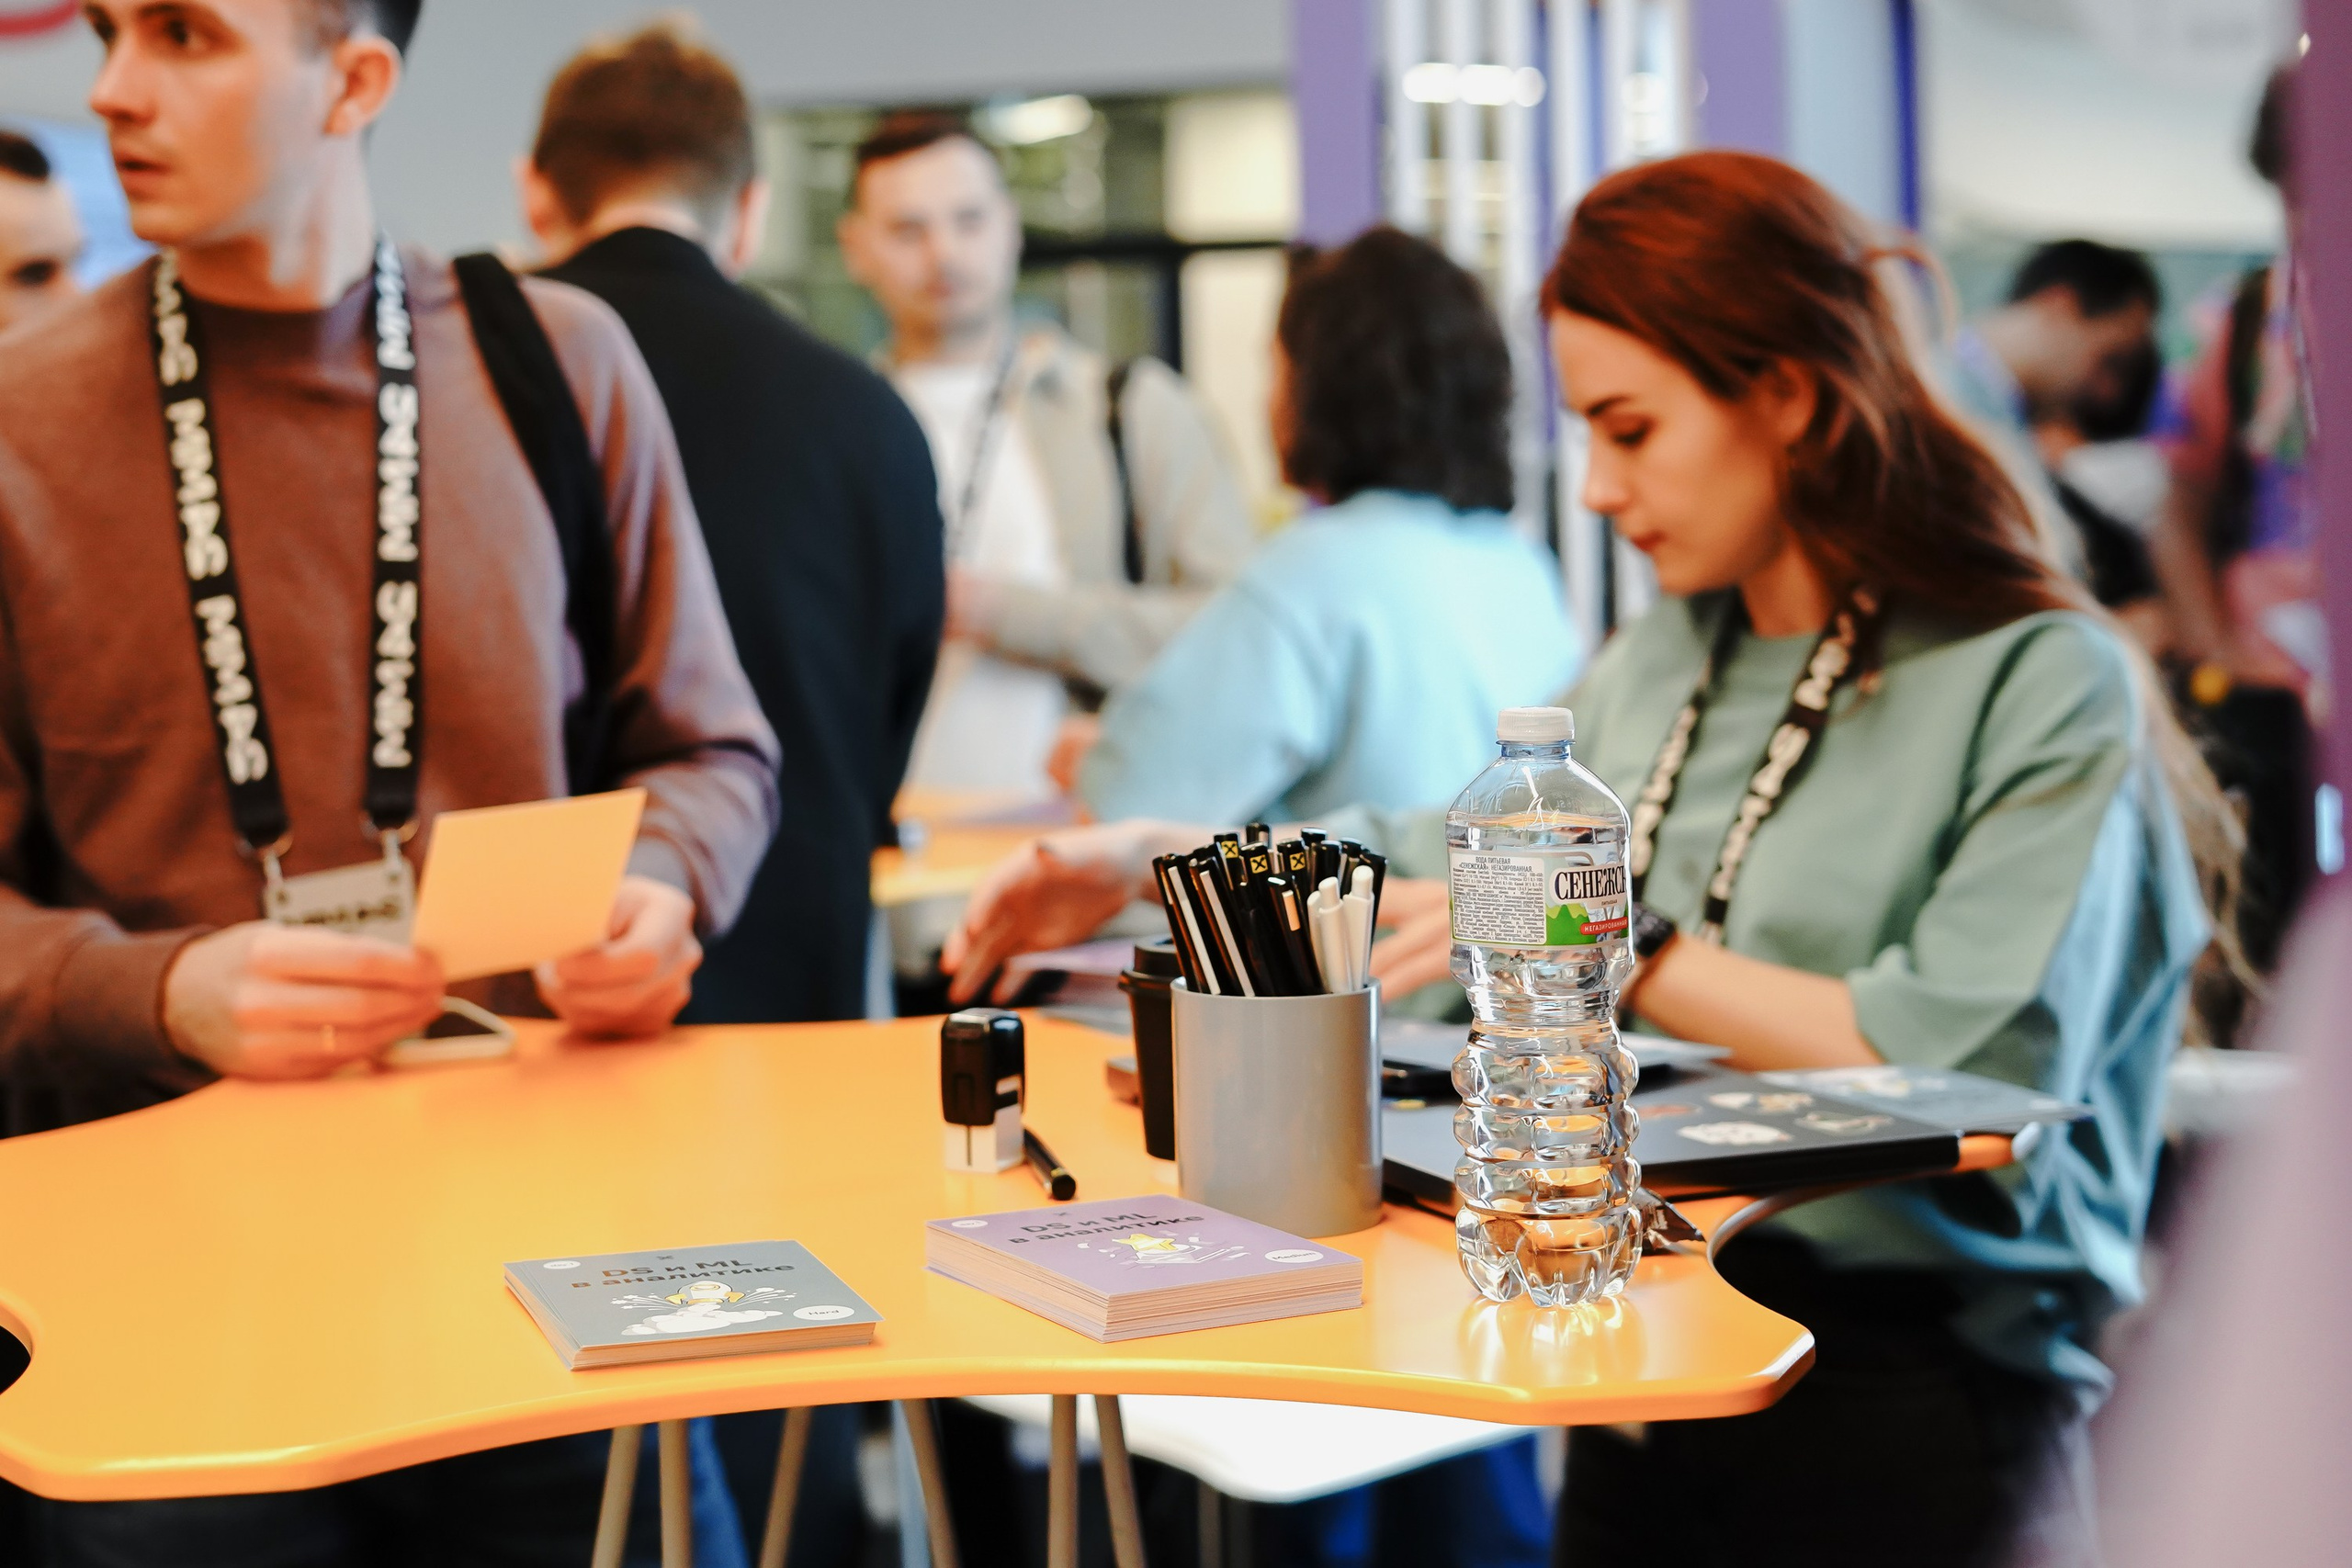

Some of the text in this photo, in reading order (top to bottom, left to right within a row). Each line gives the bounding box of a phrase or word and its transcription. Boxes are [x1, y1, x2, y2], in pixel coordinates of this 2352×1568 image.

[1021, 1223, 1071, 1233] DS
[1102, 1213, 1158, 1223] ML
[1035, 1216, 1204, 1240] аналитике
[602, 1267, 654, 1278] DS
[695, 1259, 753, 1269] ML
[602, 1266, 795, 1285] аналитике
